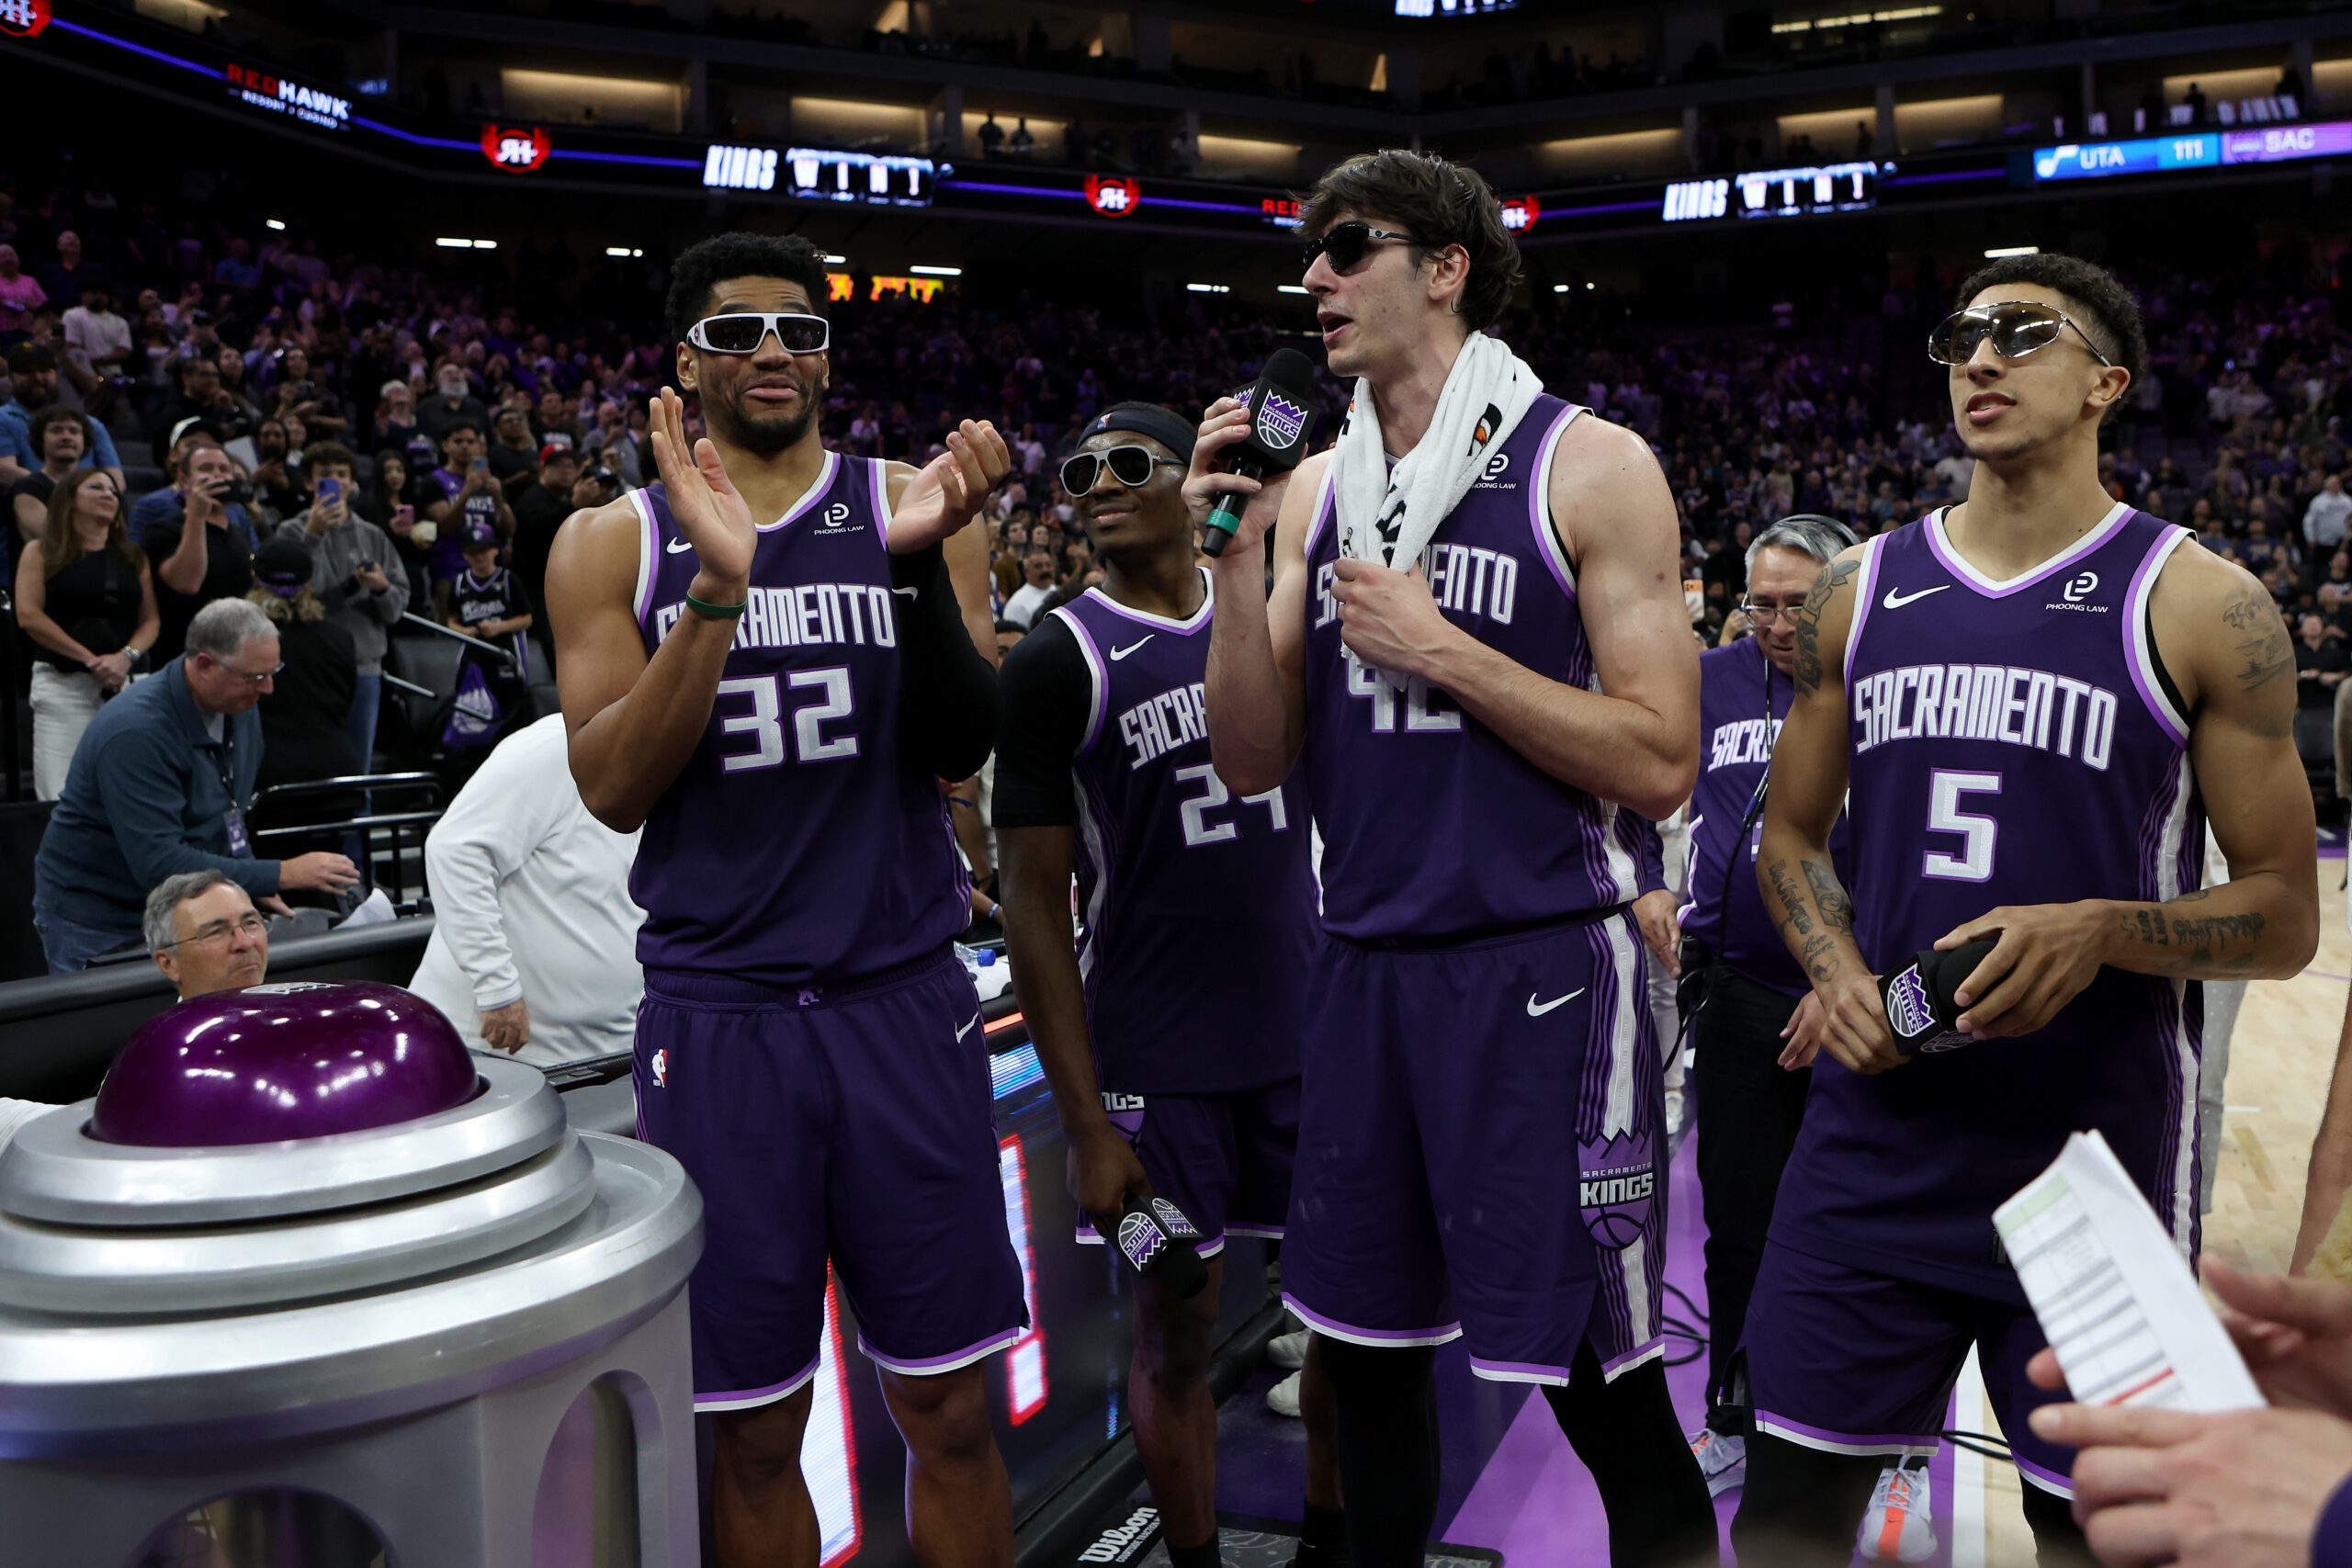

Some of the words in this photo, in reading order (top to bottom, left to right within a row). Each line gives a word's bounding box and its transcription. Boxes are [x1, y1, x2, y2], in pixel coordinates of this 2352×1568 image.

[2172, 139, 2204, 161] 111
[2265, 128, 2316, 153] SAC
[703, 144, 778, 191] KINGS
[2079, 146, 2126, 169] UTA
[1662, 178, 1729, 221] KINGS
[1260, 410, 1299, 438] KINGS
[1265, 404, 1300, 427] SACRAMENTO
[814, 527, 847, 536] PHOONG
[2045, 603, 2086, 612] PHOONG
[717, 664, 861, 774] 32
[1852, 663, 2118, 771] SACRAMENTO
[1921, 767, 2003, 883] 5
[1895, 976, 1918, 1035] KINGS
[1904, 974, 1923, 1027] SACRAMENTO
[1582, 1161, 1652, 1178] SACRAMENTO
[1579, 1172, 1654, 1207] KINGS
[1159, 1212, 1183, 1220] KINGS
[1124, 1218, 1153, 1254] KINGS
[1131, 1228, 1157, 1258] SACRAMENTO
[1077, 1506, 1159, 1563] Wilson
